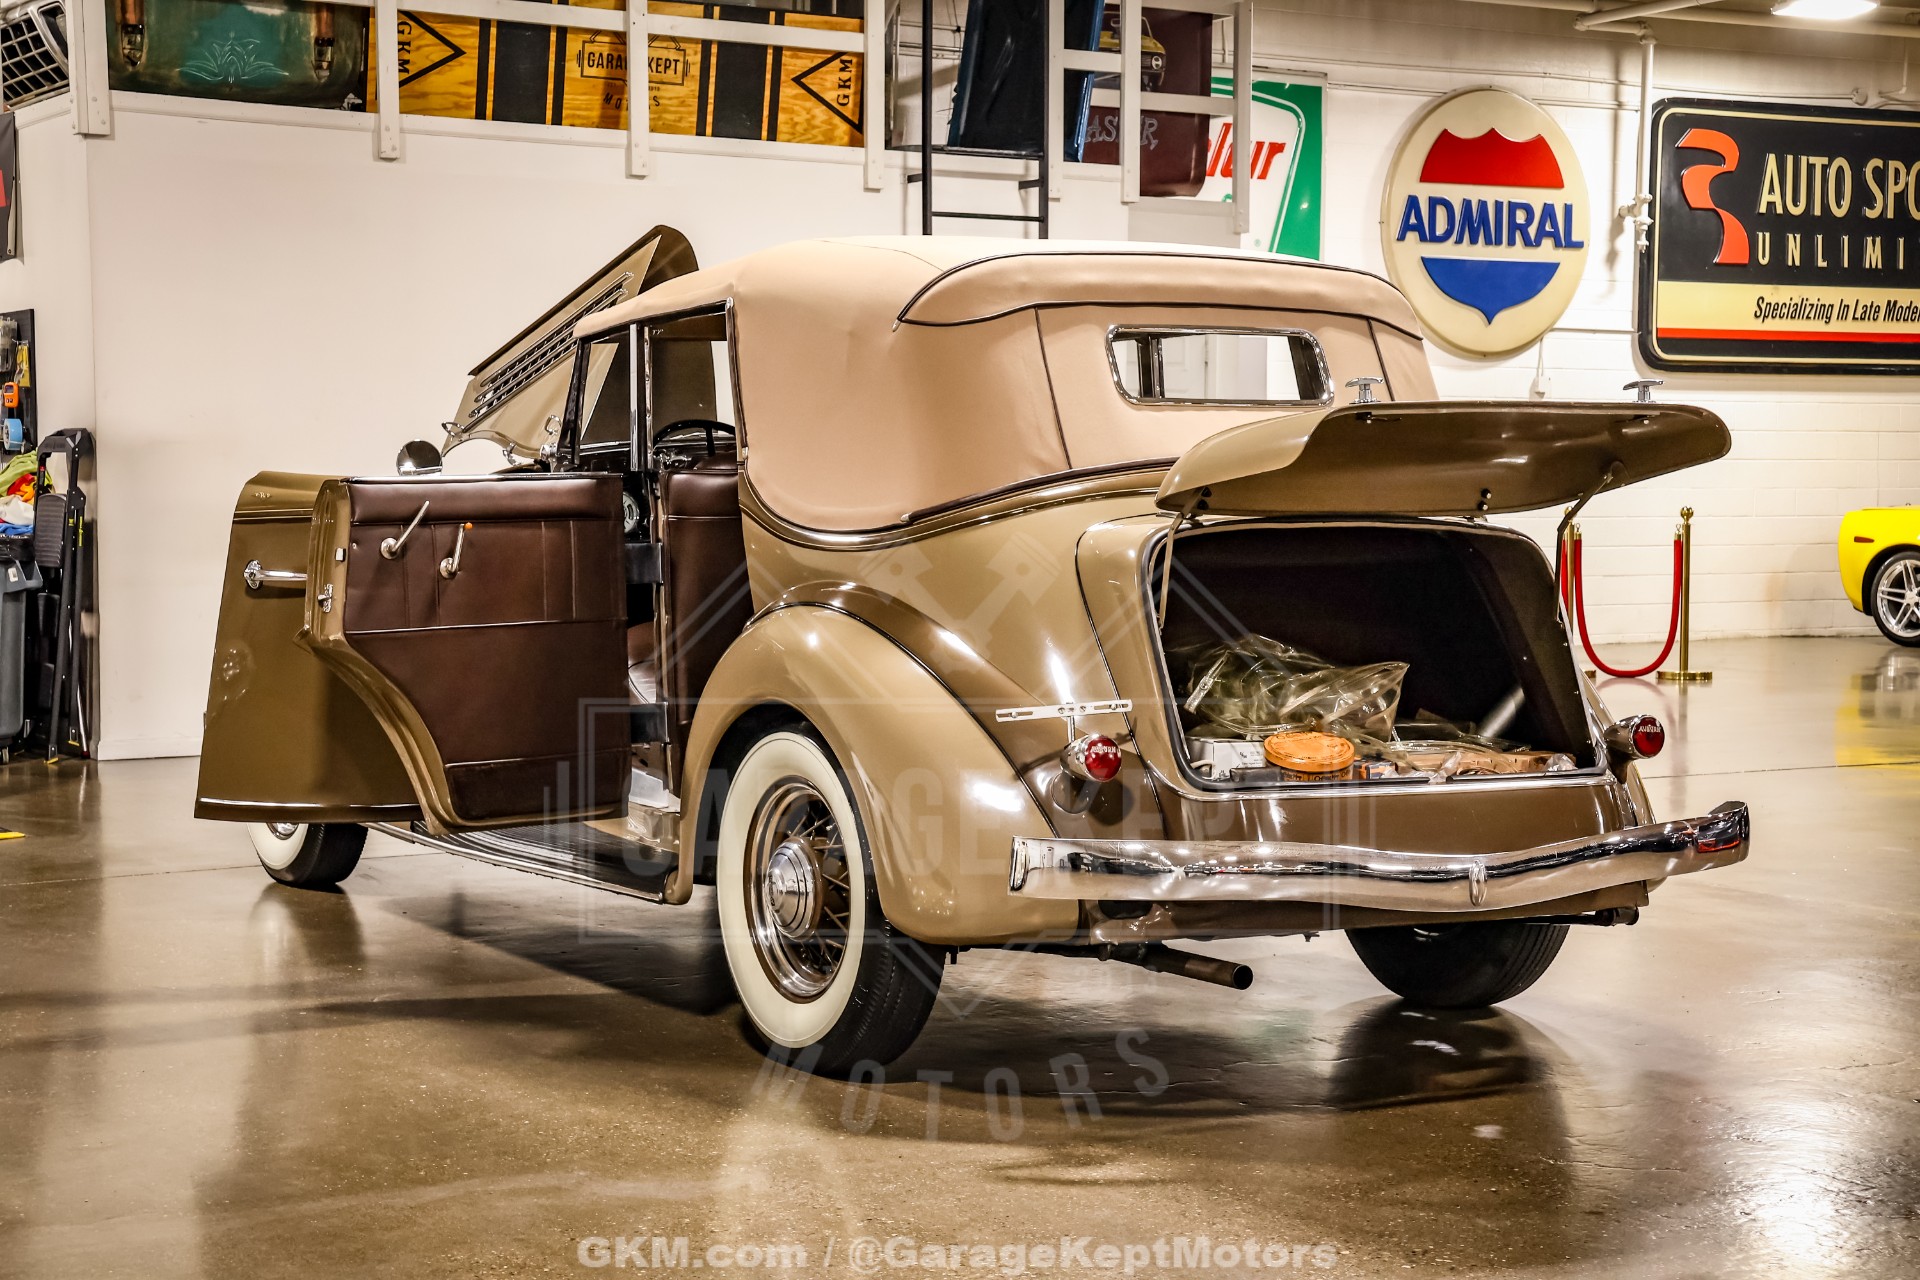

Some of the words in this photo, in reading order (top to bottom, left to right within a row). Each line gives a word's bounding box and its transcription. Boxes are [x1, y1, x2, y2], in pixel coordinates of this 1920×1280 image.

[397, 20, 412, 75] GKM
[587, 52, 628, 71] GARA
[836, 58, 853, 107] GKM
[1756, 153, 1852, 218] AUTO
[1397, 195, 1584, 249] ADMIRAL
[1757, 231, 1906, 270] UNLIMI
[1754, 295, 1834, 324] Specializing
[1836, 298, 1849, 321] In
[1852, 299, 1880, 321] Late
